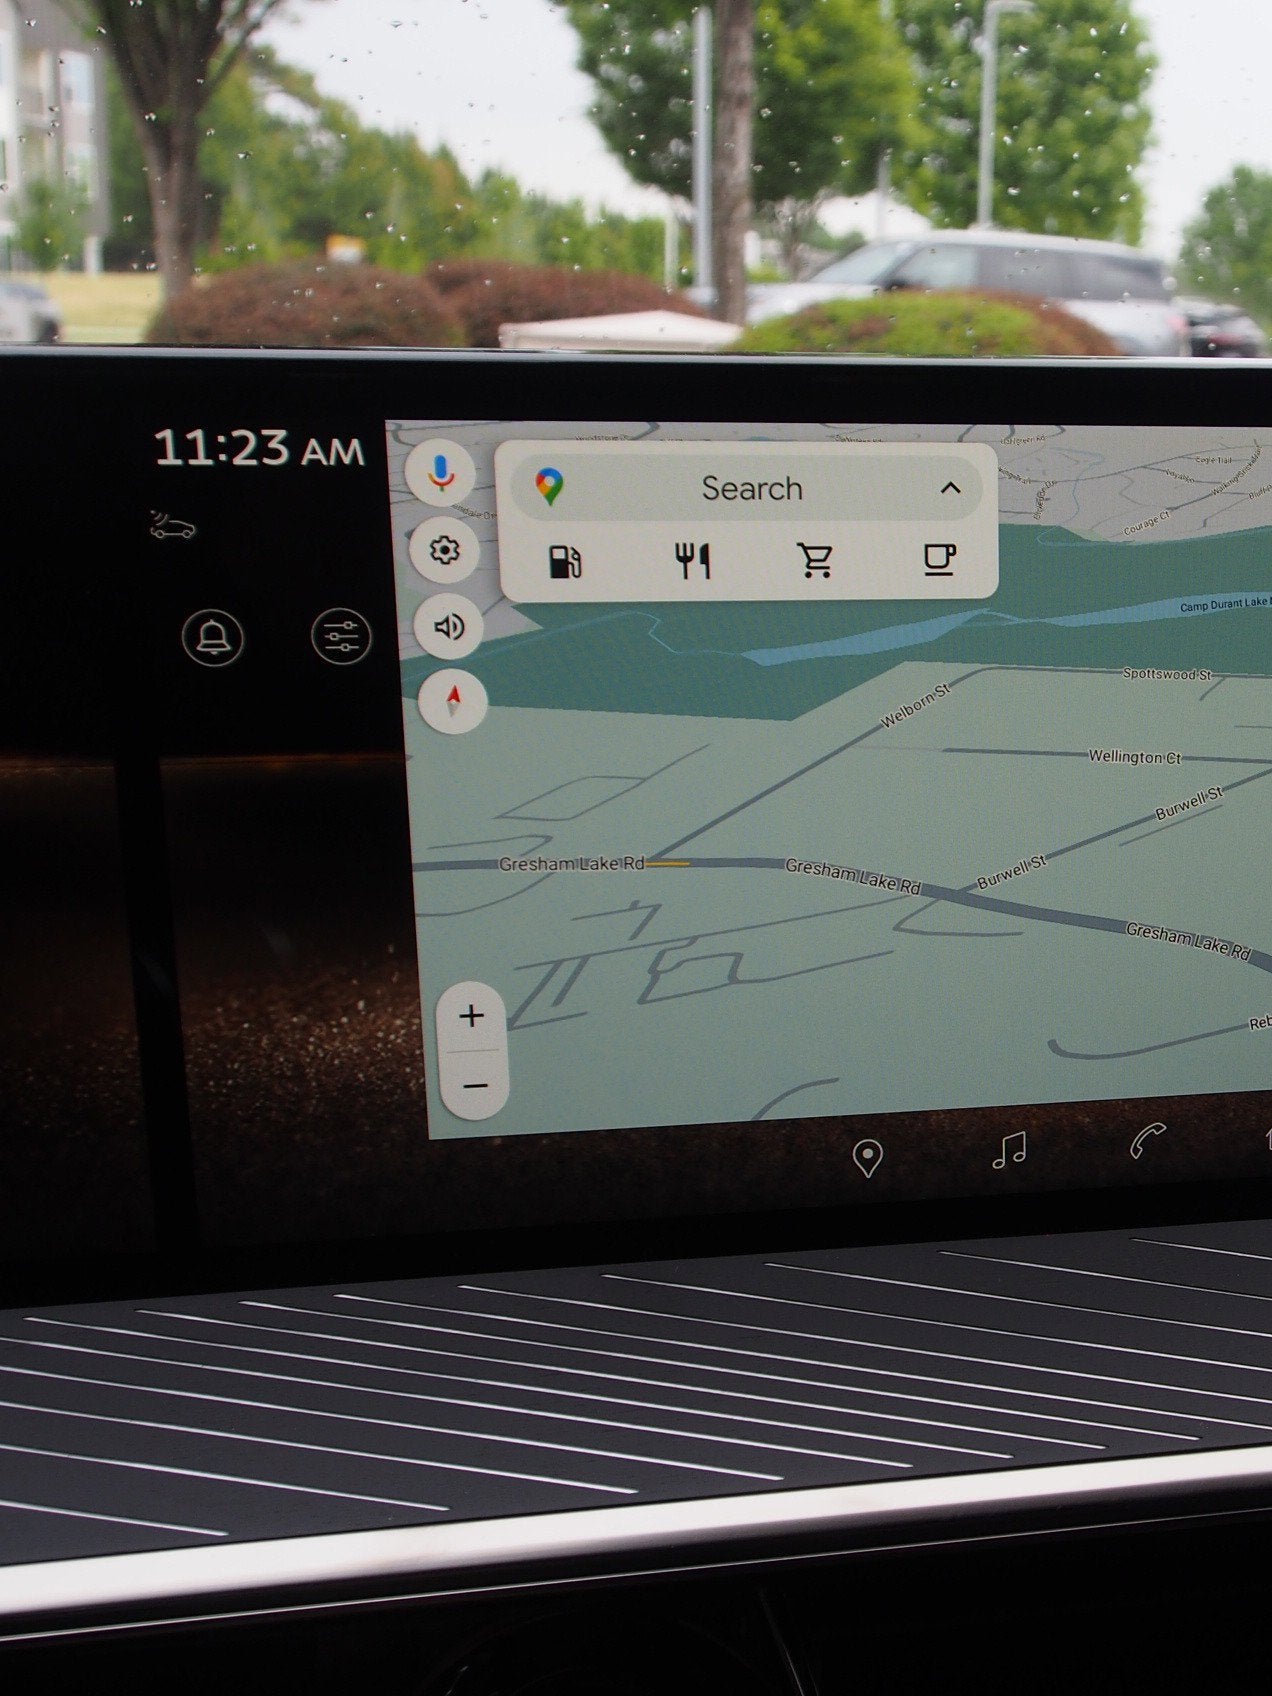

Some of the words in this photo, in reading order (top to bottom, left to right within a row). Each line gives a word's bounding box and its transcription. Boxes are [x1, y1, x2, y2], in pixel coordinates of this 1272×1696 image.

[154, 428, 290, 467] 11:23
[301, 437, 366, 467] AM
[1217, 456, 1232, 464] Trail
[702, 474, 803, 500] Search
[1249, 488, 1268, 499] Bluff
[1124, 514, 1159, 536] Courage
[1159, 510, 1170, 521] Ct
[1180, 602, 1208, 615] Camp
[1211, 599, 1243, 611] Durant
[1245, 598, 1268, 609] Lake
[1123, 666, 1197, 682] Spottswood
[1199, 669, 1212, 681] St
[880, 691, 935, 729] Welborn
[934, 683, 951, 699] St
[1089, 749, 1162, 768] Wellington
[1164, 752, 1182, 766] Ct
[1155, 791, 1207, 821] Burwell
[1206, 786, 1224, 802] St
[499, 856, 575, 872] Gresham
[580, 856, 620, 872] Lake
[624, 855, 645, 870] Rd
[785, 857, 857, 884] Gresham
[859, 870, 897, 890] Lake
[899, 878, 922, 896] Rd
[977, 860, 1030, 891] Burwell
[1029, 854, 1047, 870] St
[1126, 921, 1192, 948] Gresham
[1194, 935, 1229, 956] Lake
[1230, 944, 1252, 963] Rd
